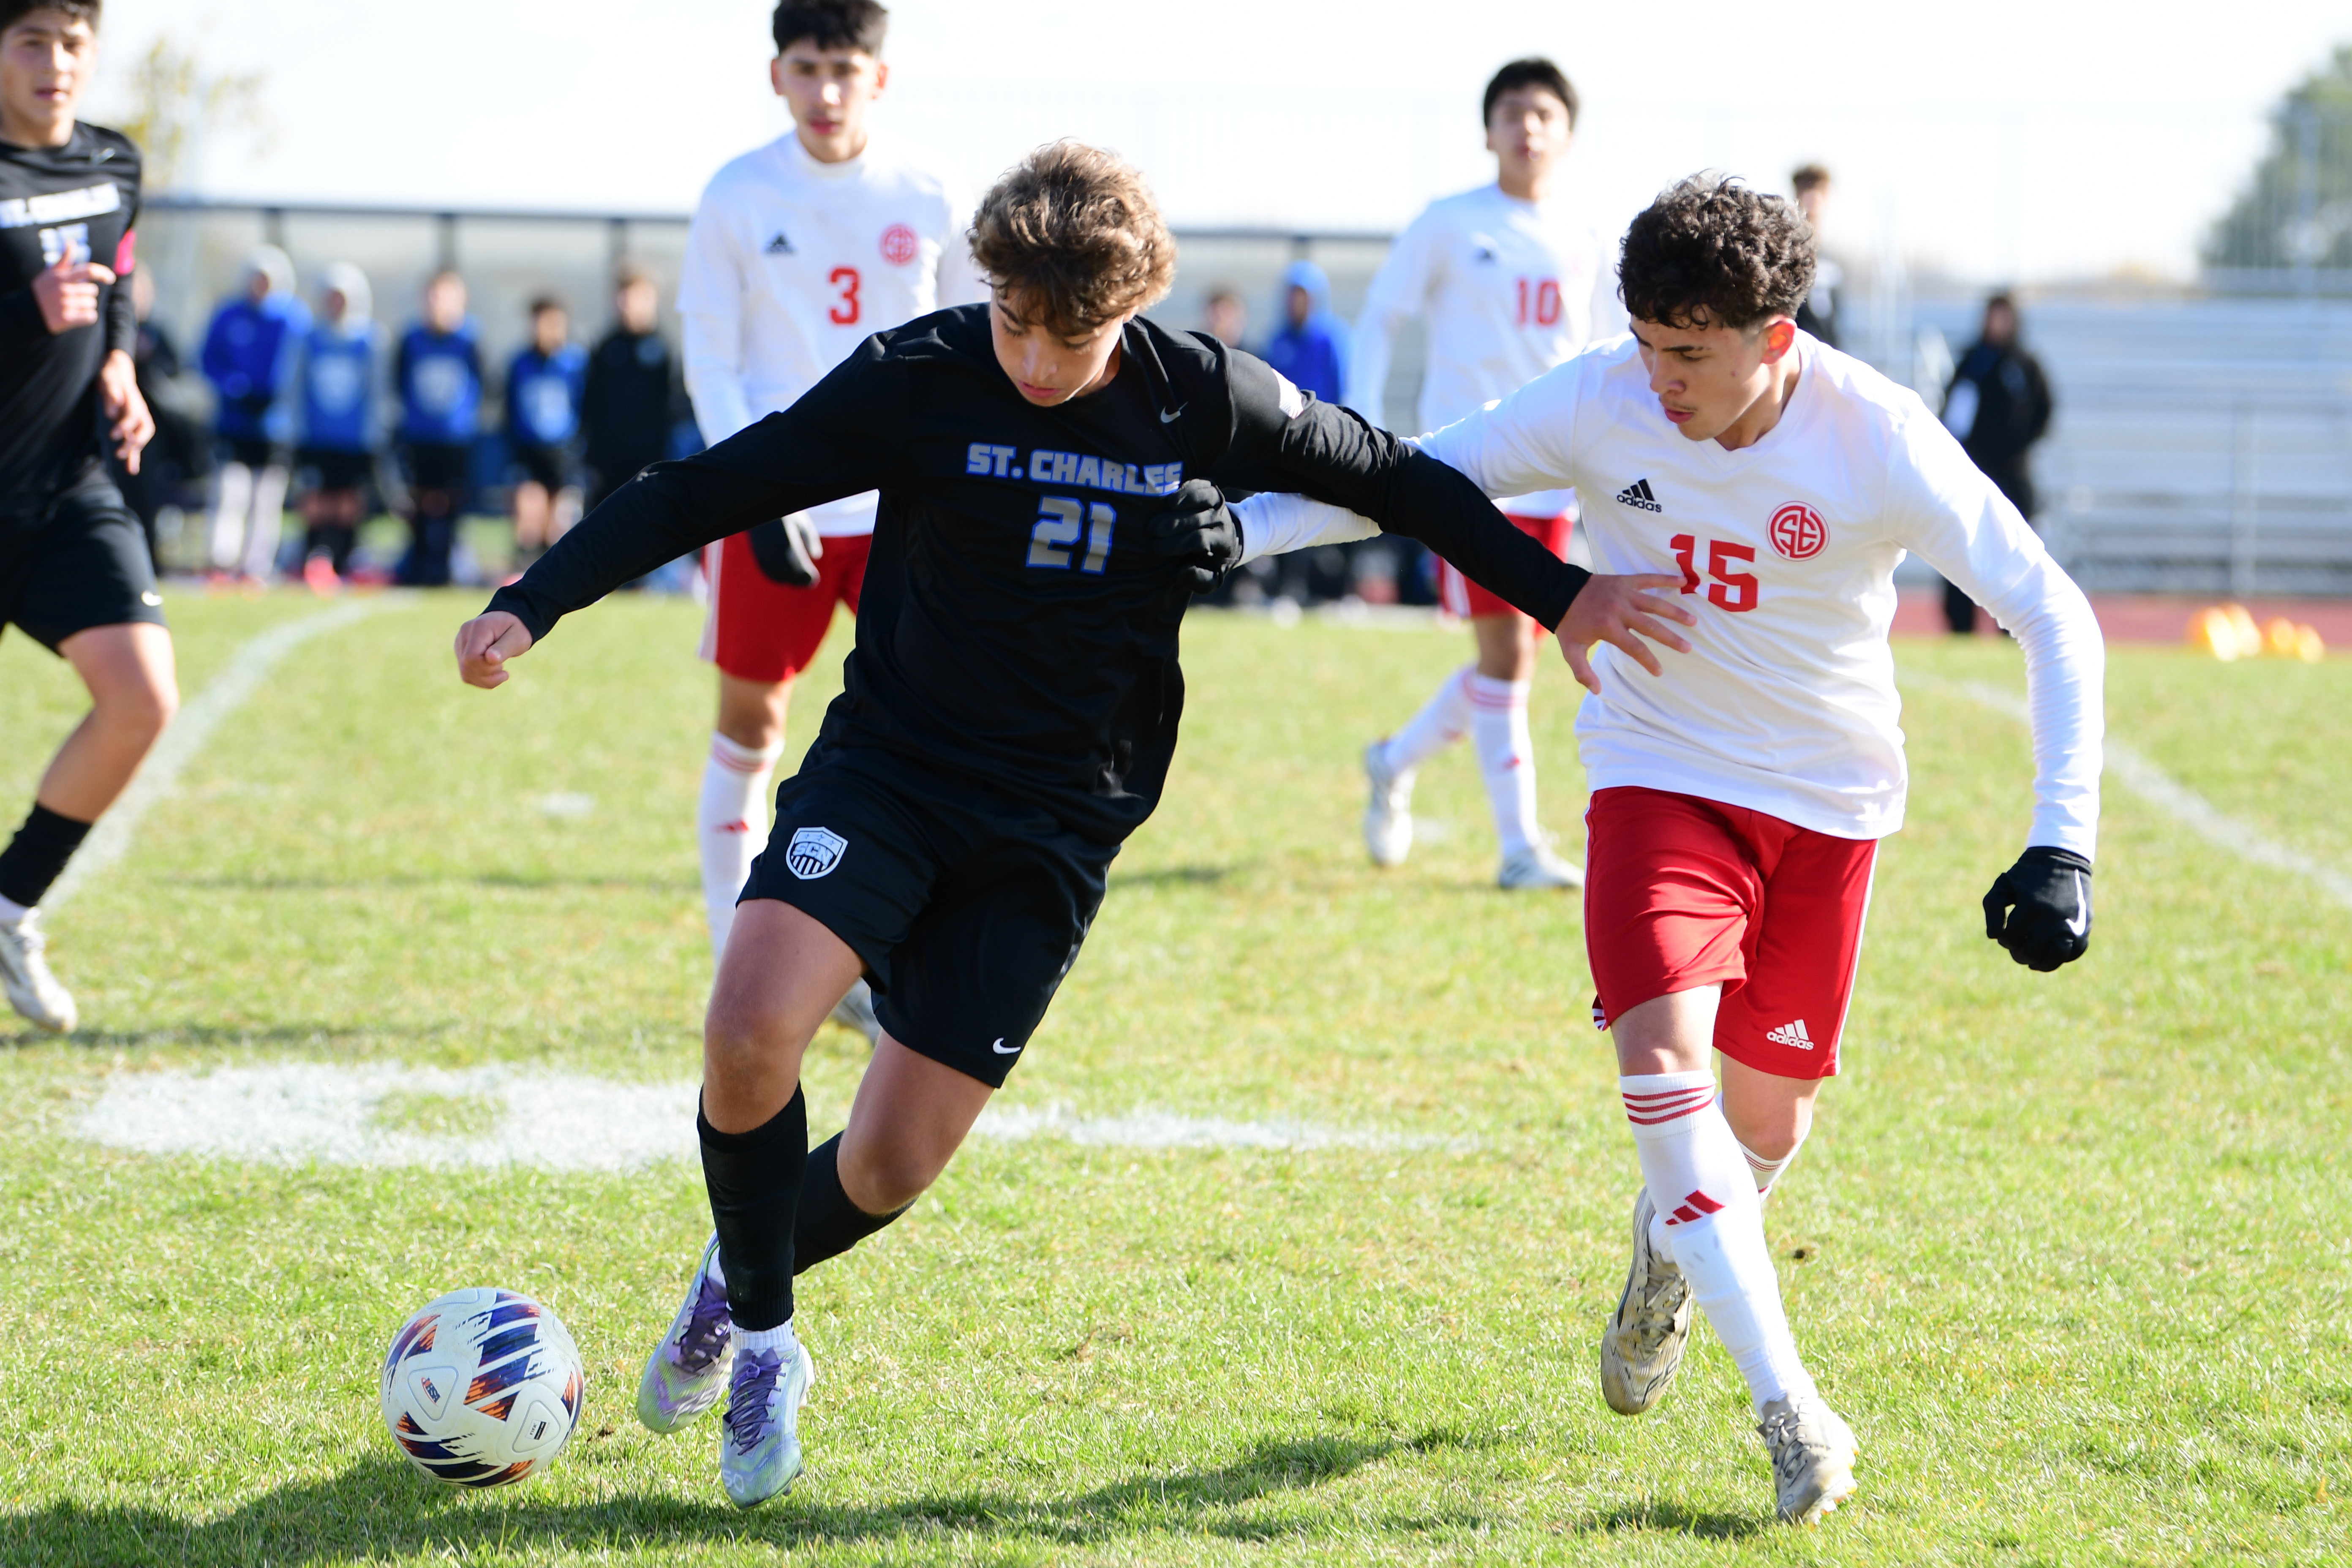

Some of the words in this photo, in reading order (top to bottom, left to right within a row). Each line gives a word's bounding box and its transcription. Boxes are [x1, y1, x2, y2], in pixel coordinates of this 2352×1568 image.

[828, 267, 860, 324] 3
[1516, 279, 1562, 327] 10
[966, 442, 1024, 479] ST.
[1029, 449, 1183, 496] CHARLES
[1617, 495, 1662, 512] adidas
[1026, 495, 1116, 574] 21
[1670, 533, 1759, 612] 15
[792, 841, 833, 867] SCN
[1766, 1031, 1814, 1051] adidas
